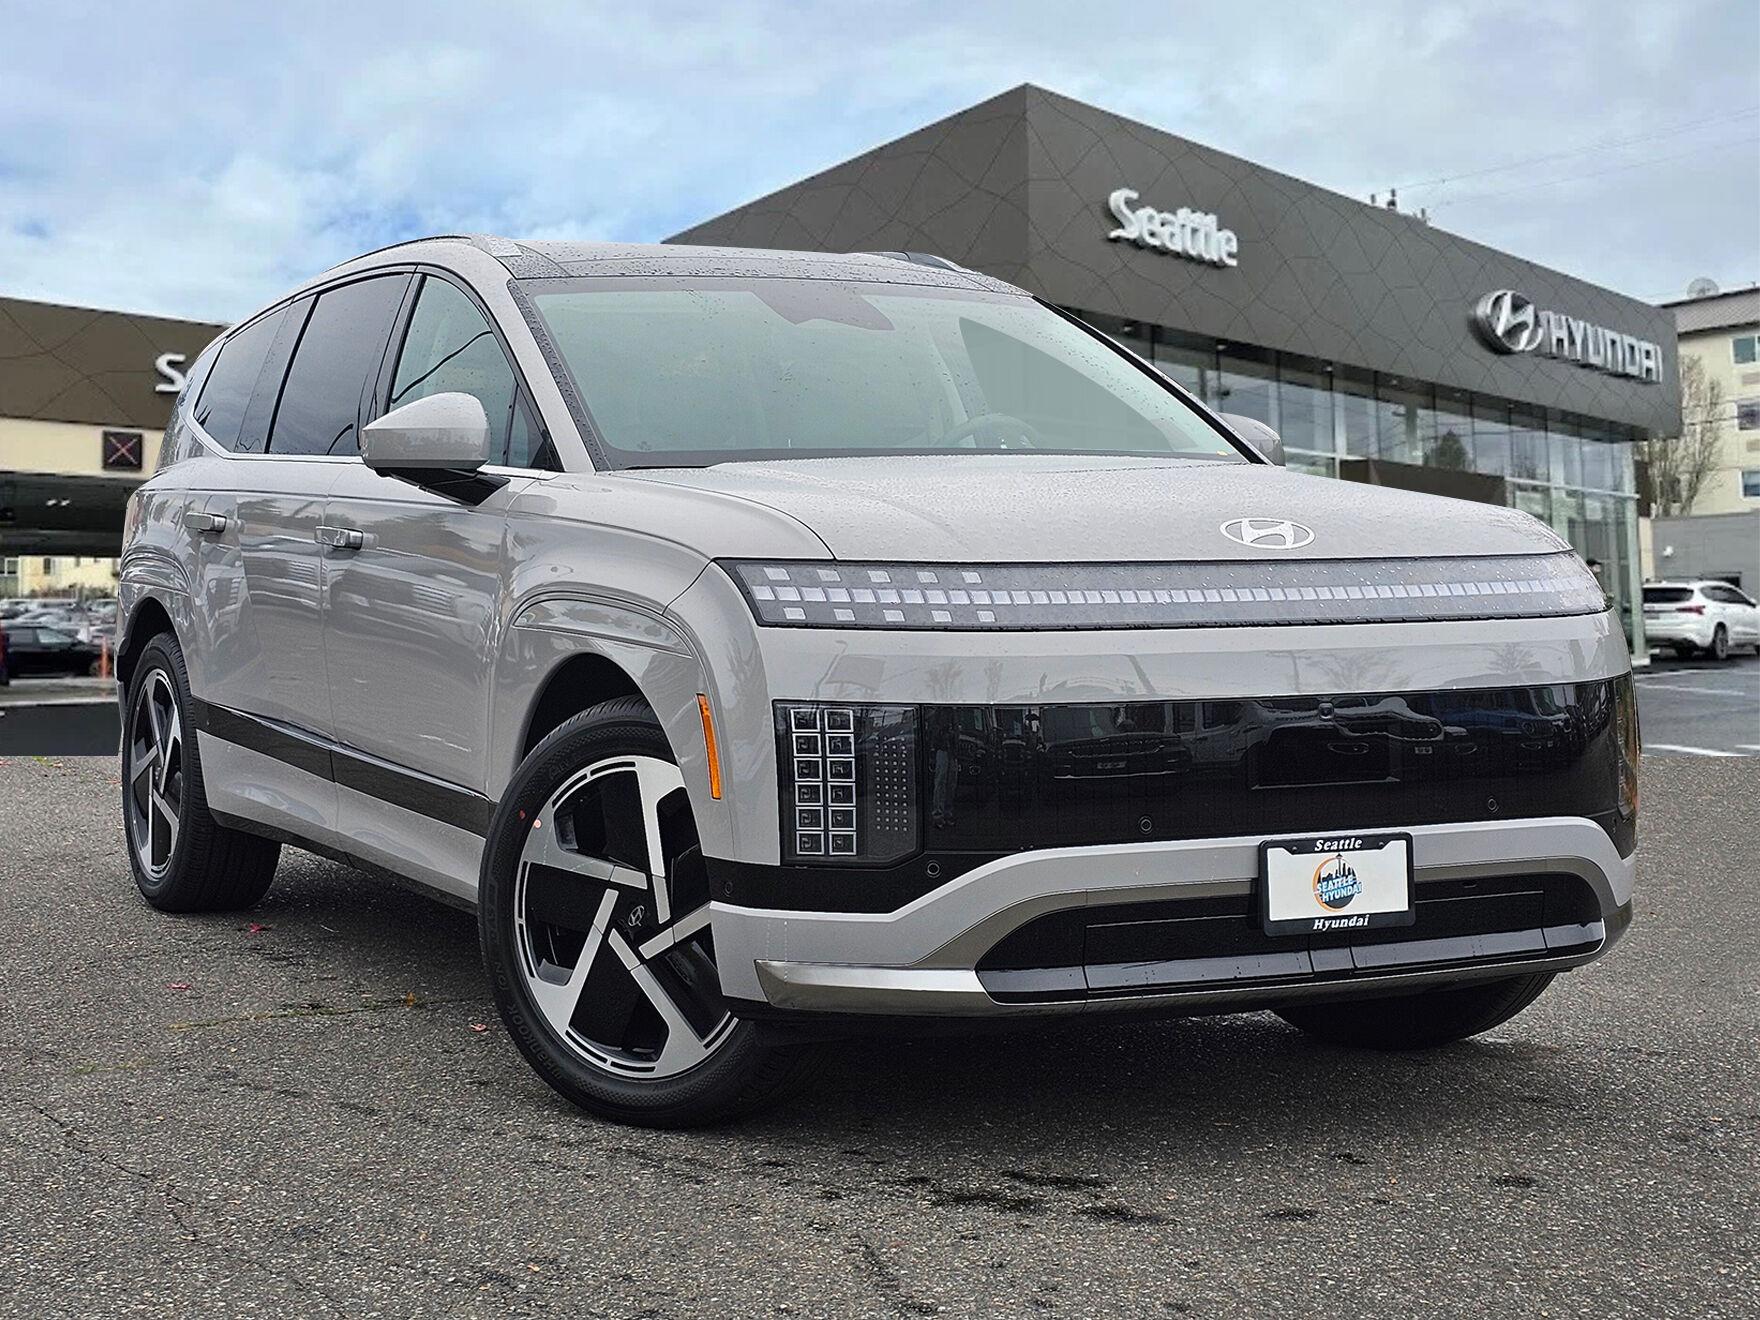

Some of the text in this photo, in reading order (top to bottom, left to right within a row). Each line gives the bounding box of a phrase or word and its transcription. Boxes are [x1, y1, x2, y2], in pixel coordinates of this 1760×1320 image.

[1108, 187, 1238, 267] Seattle
[1539, 310, 1663, 382] HYUNDAI
[1314, 838, 1363, 852] Seattle
[1321, 880, 1363, 903] HYUNDAI
[1313, 914, 1370, 931] Hyundai
